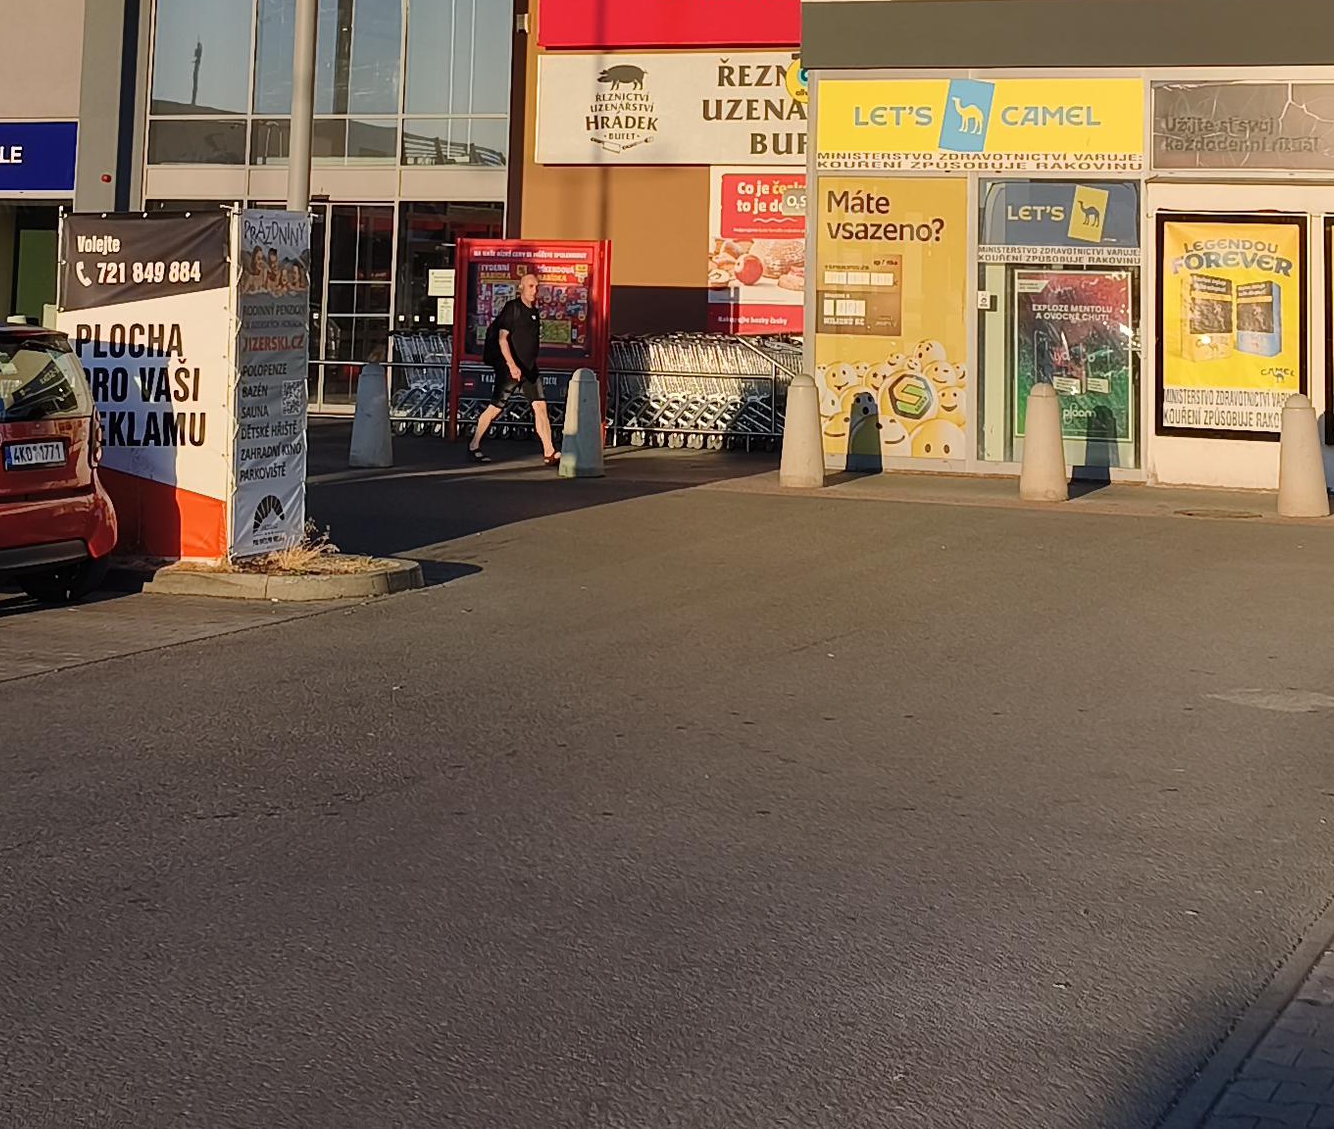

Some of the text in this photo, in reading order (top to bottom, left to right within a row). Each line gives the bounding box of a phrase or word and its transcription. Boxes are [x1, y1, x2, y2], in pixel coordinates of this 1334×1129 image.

[717, 58, 788, 87] ŘEZN
[595, 91, 649, 102] ŘEZNICTVÍ
[590, 100, 654, 112] UZENÁŘSTVÍ
[586, 110, 659, 131] HRÁDEK
[854, 106, 1101, 127] LET'S CAMEL
[750, 132, 808, 155] BUF
[817, 152, 1143, 162] MINISTERSTVO ZDRAVOTNICTVÍ VARUJE:
[817, 160, 1143, 171] KOUŘENÍ ZPŮSOBUJE RAKOVINU
[736, 182, 755, 195] Co
[755, 181, 770, 198] je
[736, 200, 752, 213] to
[753, 198, 767, 216] je
[826, 189, 890, 215] Máte
[1007, 204, 1065, 221] LET'S
[826, 218, 945, 242] vsazeno?
[77, 235, 121, 256] Volejte
[978, 246, 1038, 255] MINISTERSTVO
[1040, 247, 1104, 256] ZDRAVOTNICTVÍ
[1184, 239, 1279, 254] LEGENDOU
[1088, 256, 1141, 265] RAKOVINU
[1172, 251, 1294, 278] FOREVER
[97, 260, 202, 284] 721 849 884
[1035, 312, 1042, 320] A
[76, 323, 184, 359] PLOCHA
[139, 358, 201, 403] VAŠI
[241, 382, 268, 398] BAZÉN
[1164, 389, 1213, 405] MINISTERSTVO
[1215, 390, 1271, 407] ZDRAVOTNICTVÍ
[241, 406, 269, 419] SAUNA
[1164, 407, 1280, 429] KOUŘENÍ ZPŮSOBUJE RAKO
[99, 412, 207, 448] EKLAMU
[241, 421, 298, 440] DĚTSKÉ HŘIŠTĚ
[240, 443, 281, 461] ZAHRADNÍ
[240, 462, 287, 482] PARKOVIŠTĚ
